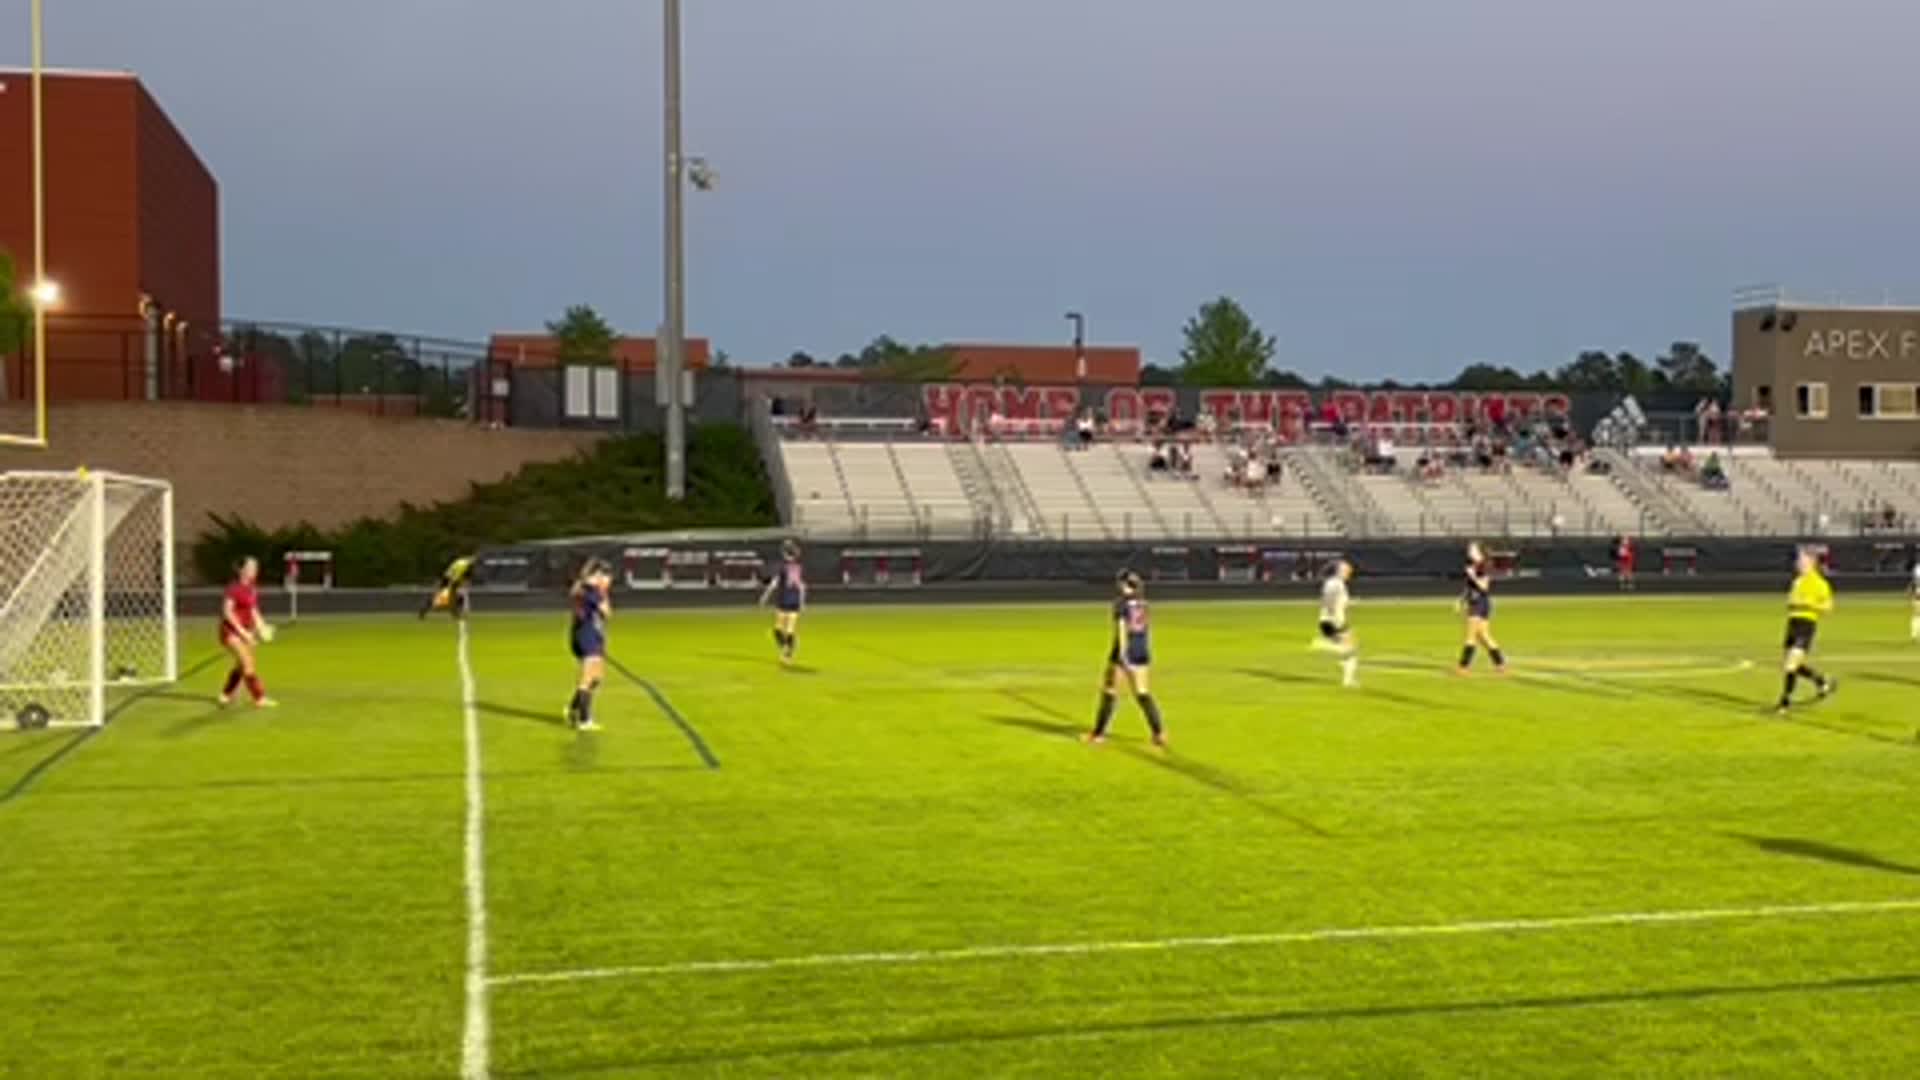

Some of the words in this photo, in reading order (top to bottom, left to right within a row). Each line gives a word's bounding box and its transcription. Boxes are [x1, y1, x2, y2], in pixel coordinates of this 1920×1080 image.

[1804, 330, 1890, 359] APEX
[924, 384, 1079, 440] HOME
[1107, 386, 1176, 441] OF
[1200, 388, 1309, 444] THE
